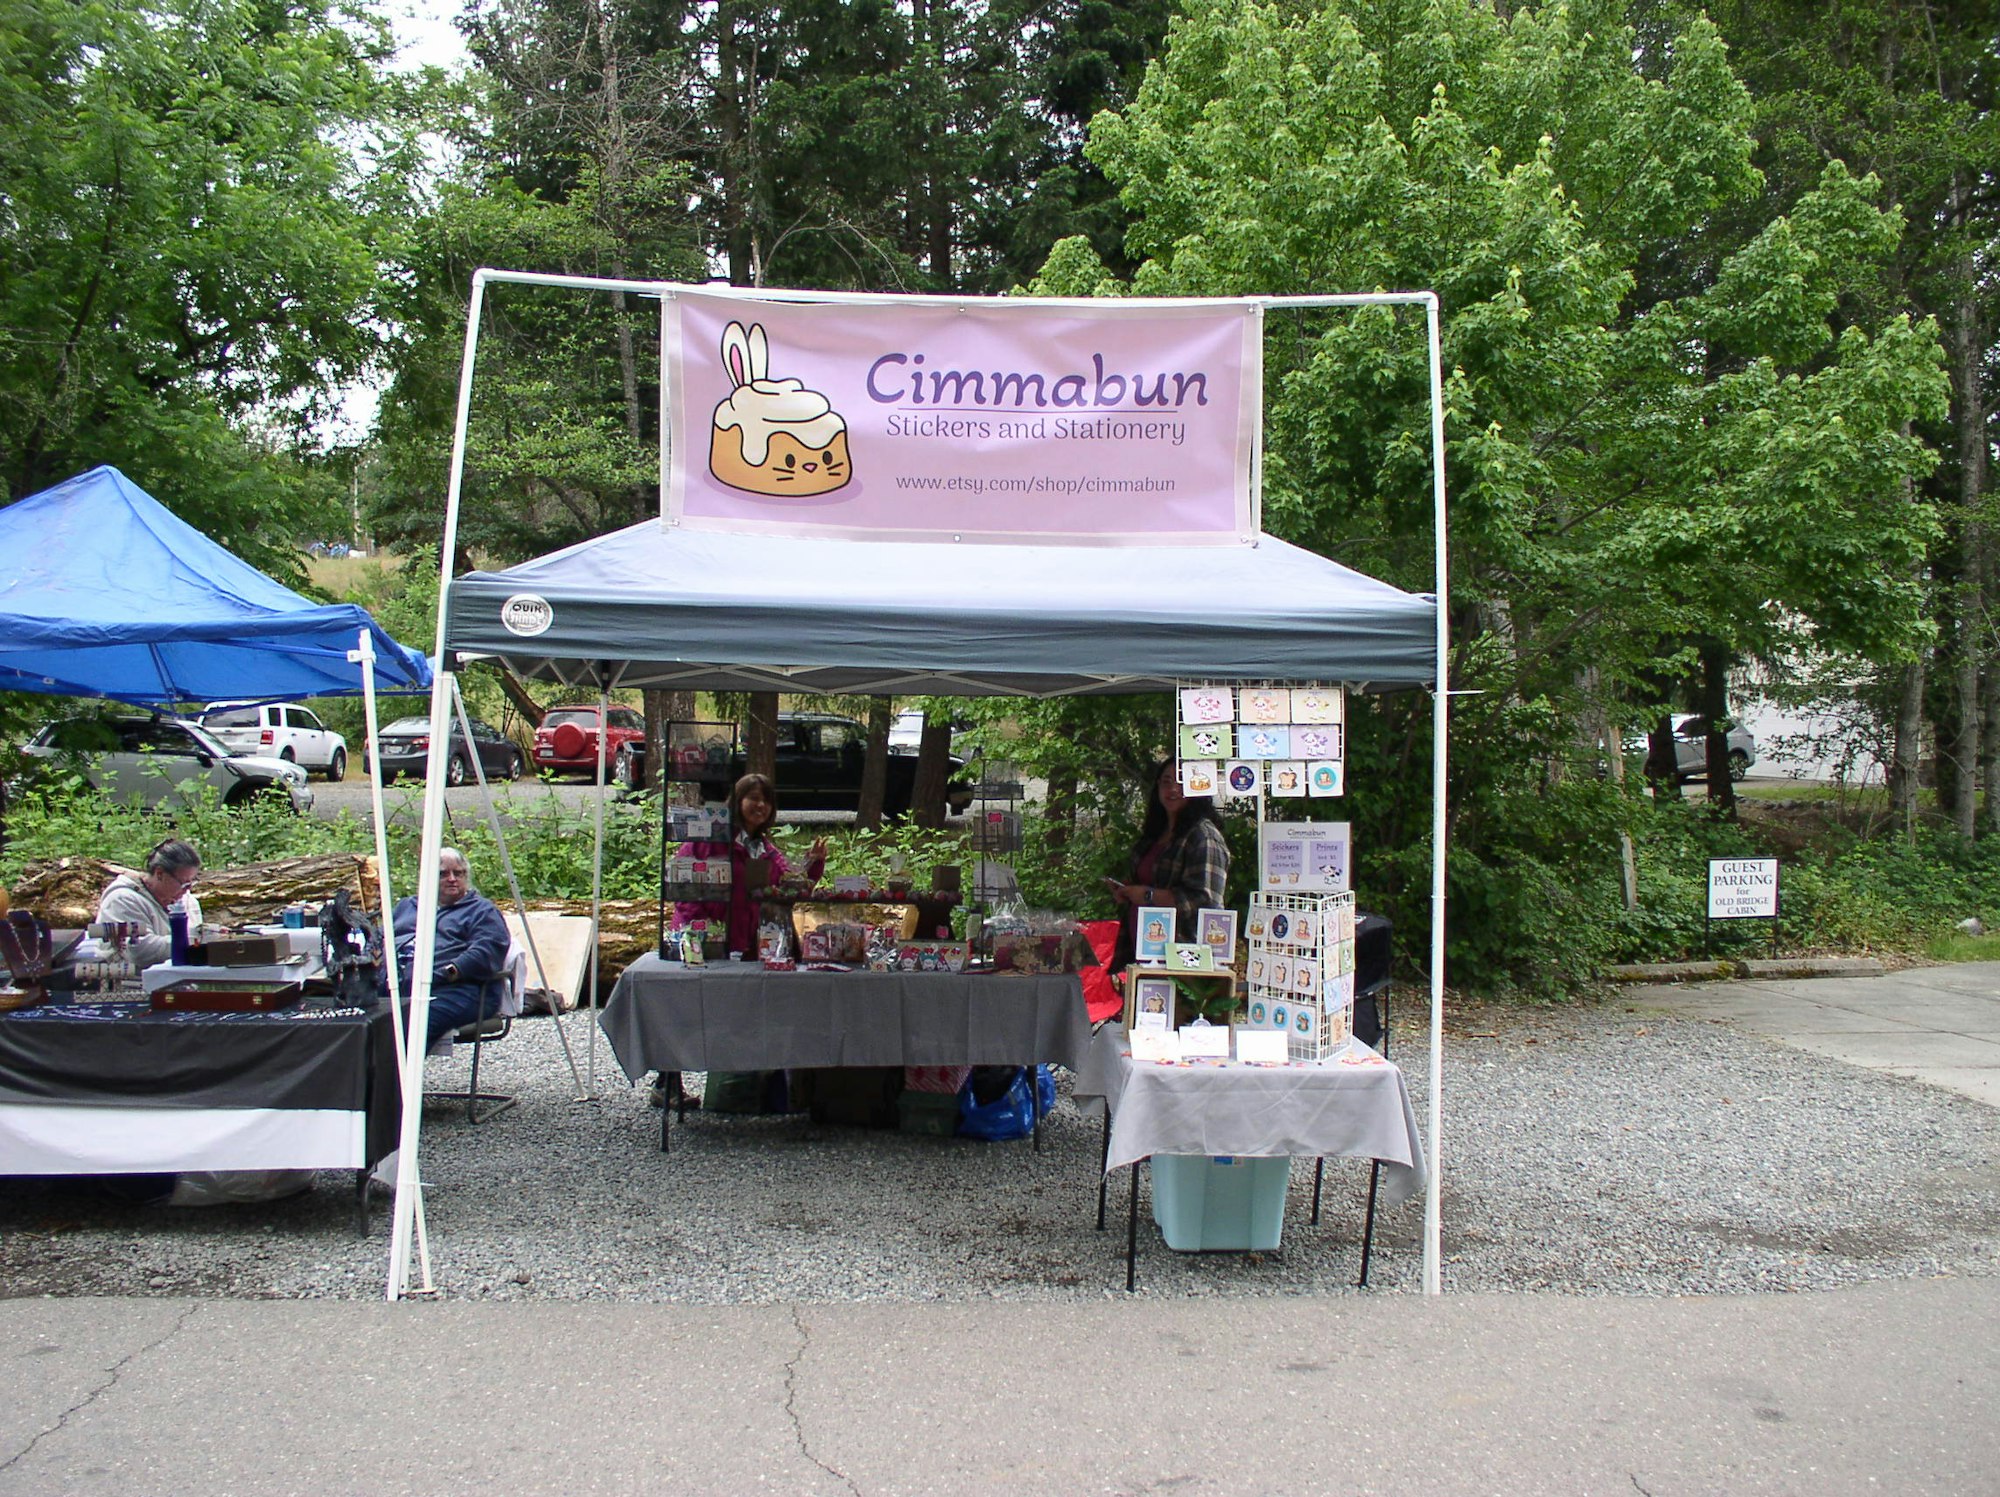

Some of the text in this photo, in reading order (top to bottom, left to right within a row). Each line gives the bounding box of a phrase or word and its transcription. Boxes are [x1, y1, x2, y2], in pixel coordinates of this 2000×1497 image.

[867, 353, 1208, 407] Cimmabun
[887, 414, 1185, 446] Stickers and Stationery
[896, 475, 1176, 496] www.etsy.com/shop/cimmabun
[512, 604, 542, 612] QUIK
[1722, 862, 1764, 873] GUEST
[1714, 875, 1773, 886] PARKING
[1736, 888, 1750, 896] for
[1715, 897, 1769, 906] OLD BRIDGE
[1727, 906, 1757, 915] CABIN
